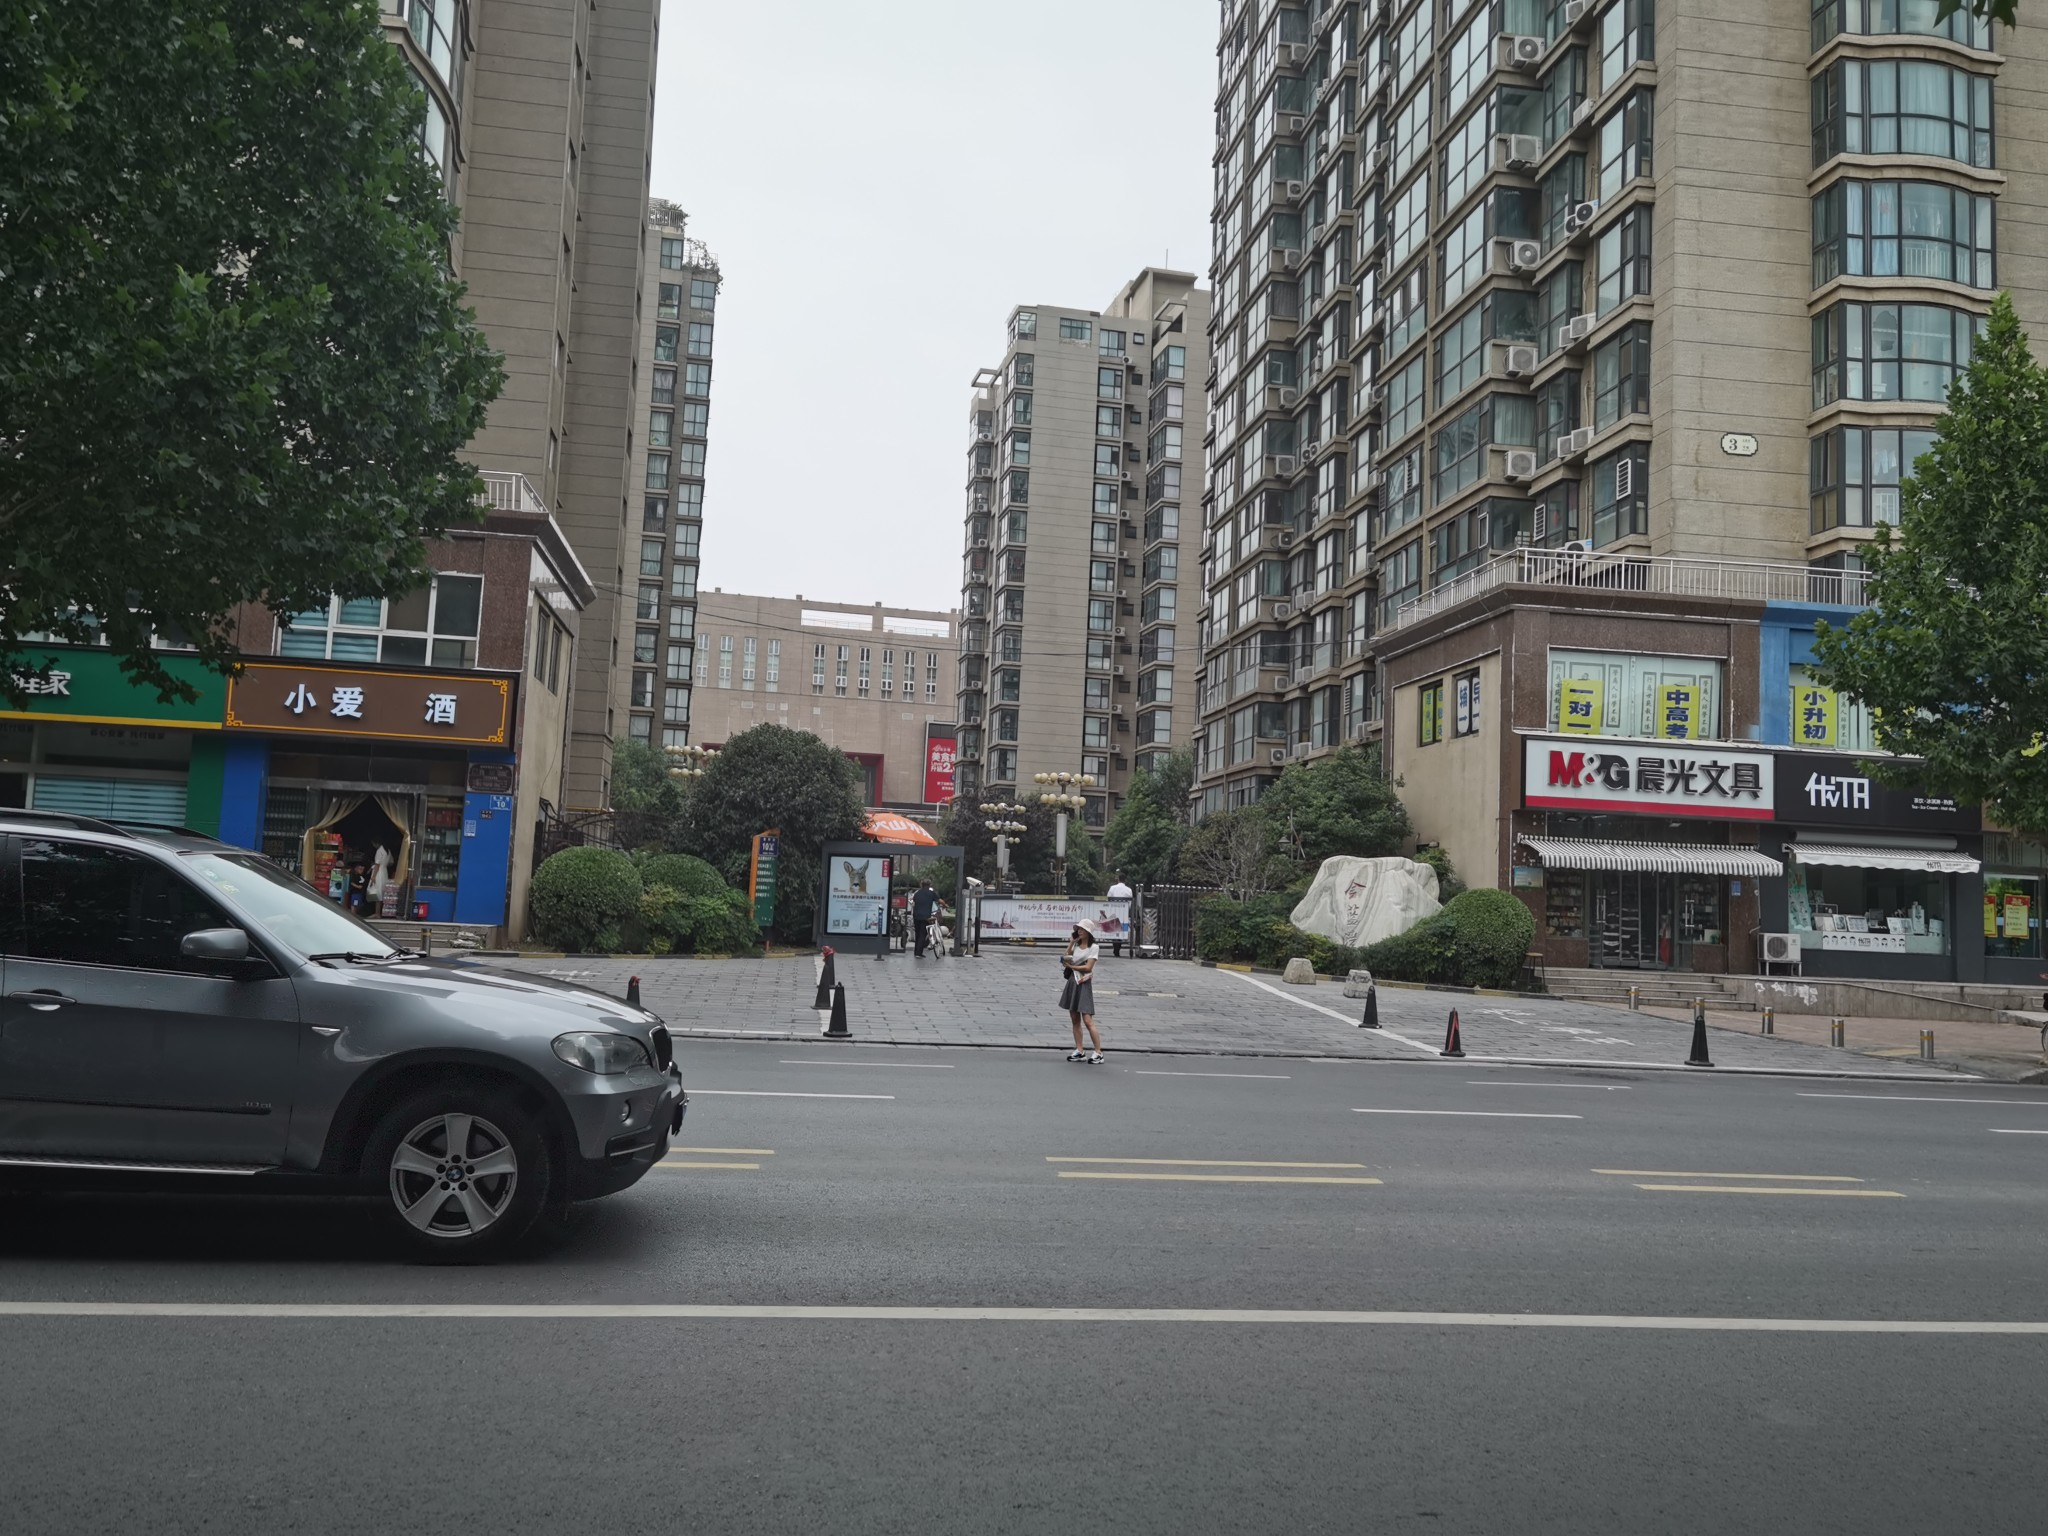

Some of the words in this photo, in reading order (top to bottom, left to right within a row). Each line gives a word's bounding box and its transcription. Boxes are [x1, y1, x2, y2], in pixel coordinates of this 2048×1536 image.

[284, 683, 364, 718] 小爱
[424, 692, 457, 725] 酒
[1567, 688, 1594, 728] 一对一
[1665, 689, 1690, 739] 中高考
[1803, 690, 1828, 740] 小升初
[1548, 750, 1630, 790] M&G
[1635, 756, 1763, 799] 晨光文具
